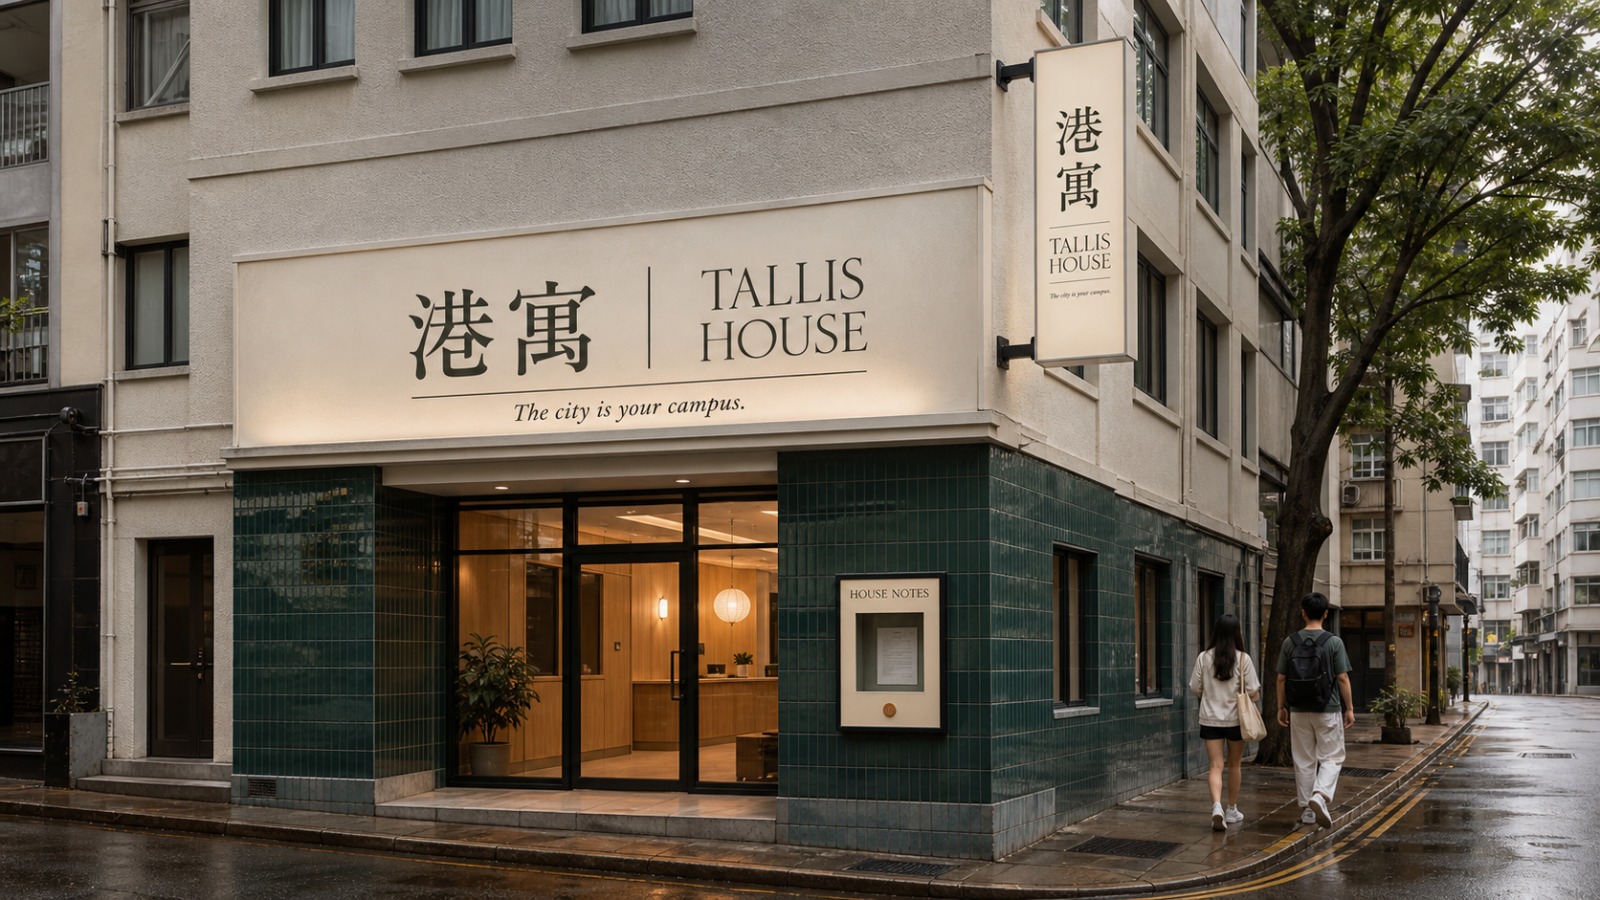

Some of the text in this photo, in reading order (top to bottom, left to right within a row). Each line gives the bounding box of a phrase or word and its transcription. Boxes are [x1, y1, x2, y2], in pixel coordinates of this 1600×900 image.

[1056, 106, 1103, 212] 港寓
[1049, 232, 1111, 255] TALLIS
[1049, 253, 1111, 274] HOUSE
[701, 257, 864, 311] TALLIS
[408, 280, 596, 380] 港寓
[700, 311, 868, 362] HOUSE
[514, 397, 745, 425] The city is your campus.
[850, 588, 930, 600] HOUSE NOTES
